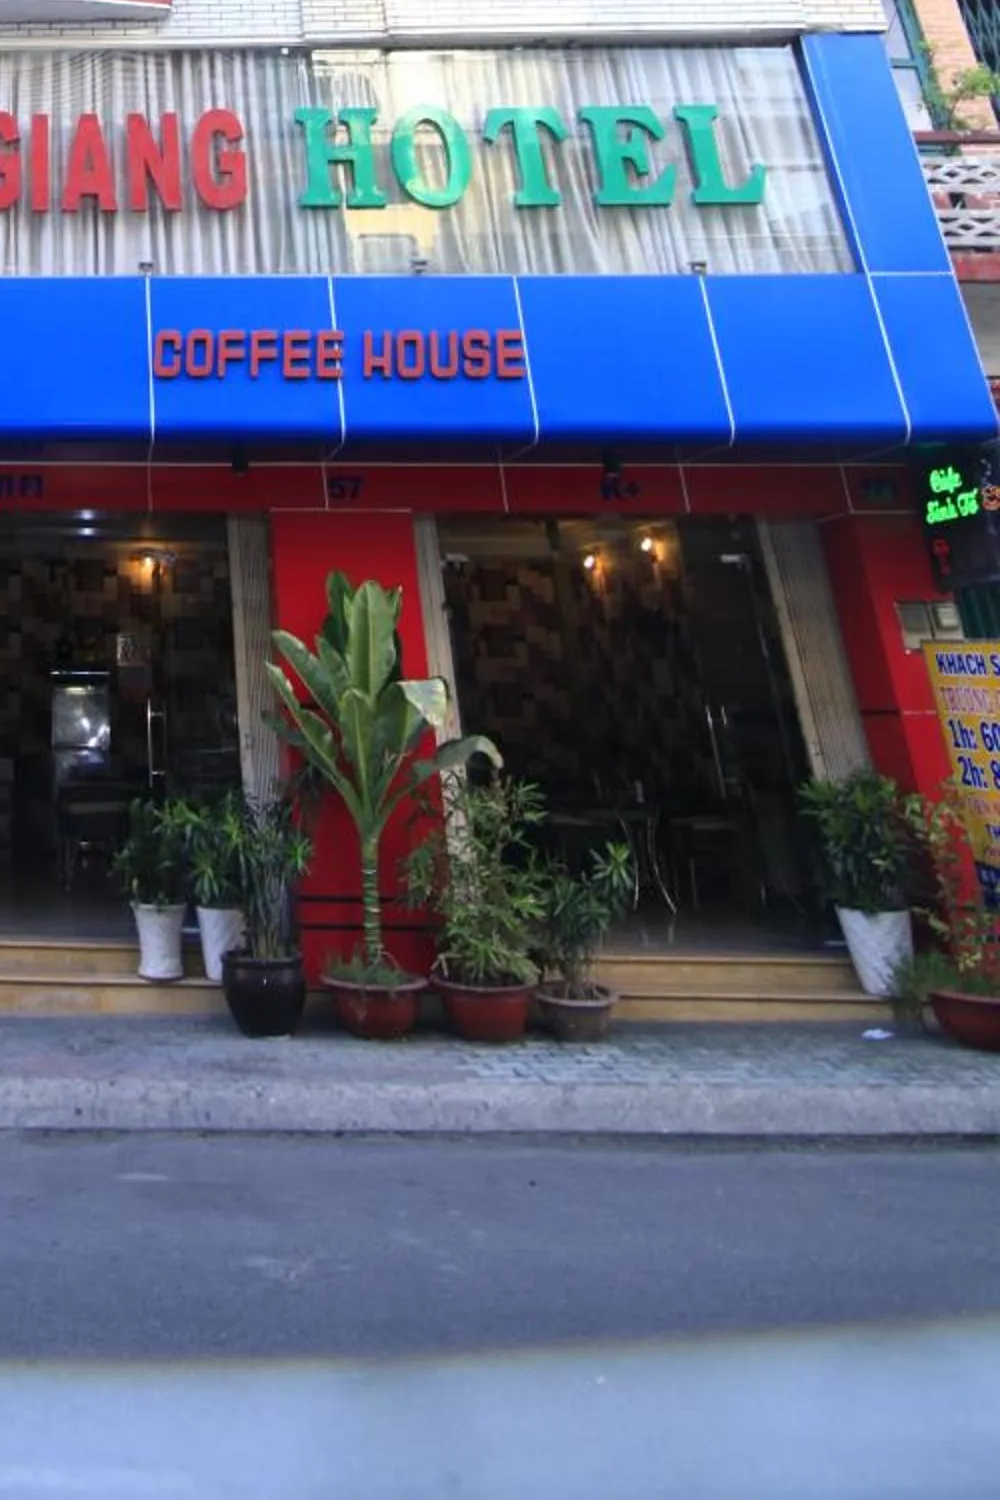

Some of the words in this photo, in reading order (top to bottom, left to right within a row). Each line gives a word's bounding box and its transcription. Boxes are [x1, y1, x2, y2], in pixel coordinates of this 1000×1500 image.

[295, 104, 767, 209] HOTEL
[153, 329, 345, 380] COFFEE
[362, 329, 525, 380] HOUSE
